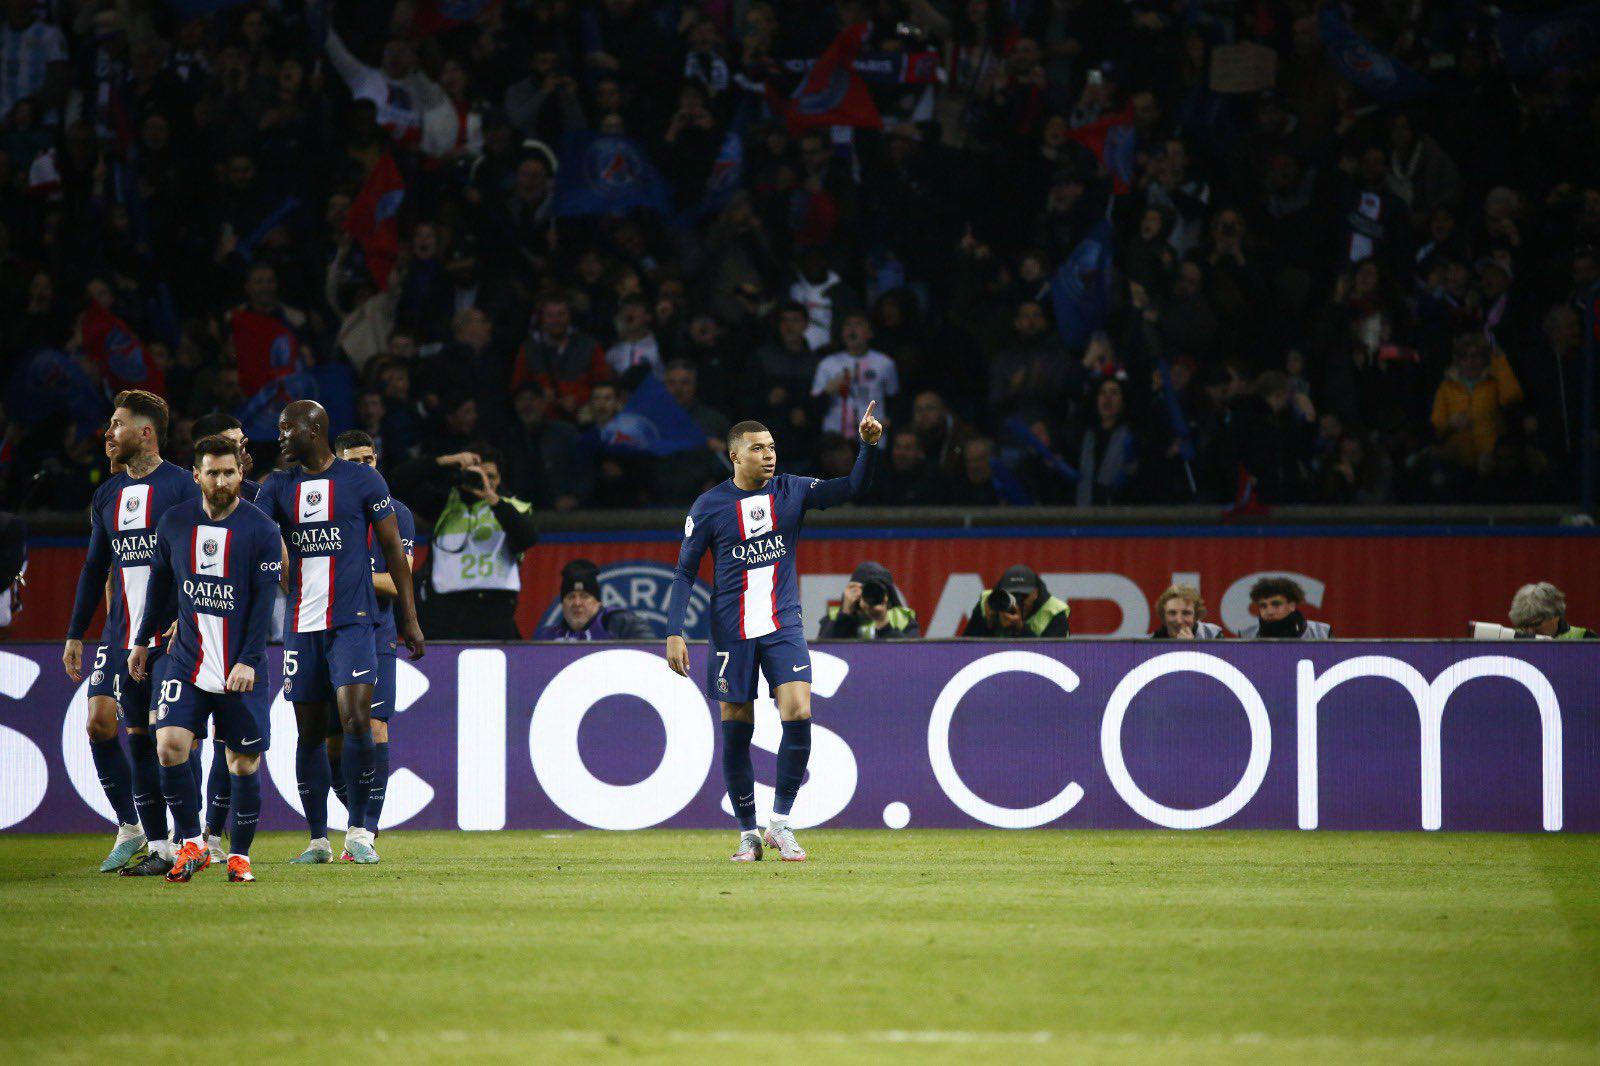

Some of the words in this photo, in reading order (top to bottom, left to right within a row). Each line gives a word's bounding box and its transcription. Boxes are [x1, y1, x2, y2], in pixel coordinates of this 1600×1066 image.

[372, 494, 392, 512] GOA
[291, 527, 342, 547] QATAR
[300, 541, 342, 553] AIRWAYS
[731, 534, 785, 561] QATAR
[260, 560, 283, 572] GOA
[460, 553, 493, 580] 25
[746, 547, 787, 565] AIRWAYS
[183, 580, 234, 599] QATAR
[193, 597, 235, 610] AIRWAYS
[600, 577, 705, 628] ARIS
[93, 646, 109, 670] 5
[283, 650, 298, 676] 15
[716, 651, 730, 678] 7
[157, 679, 183, 705] 30
